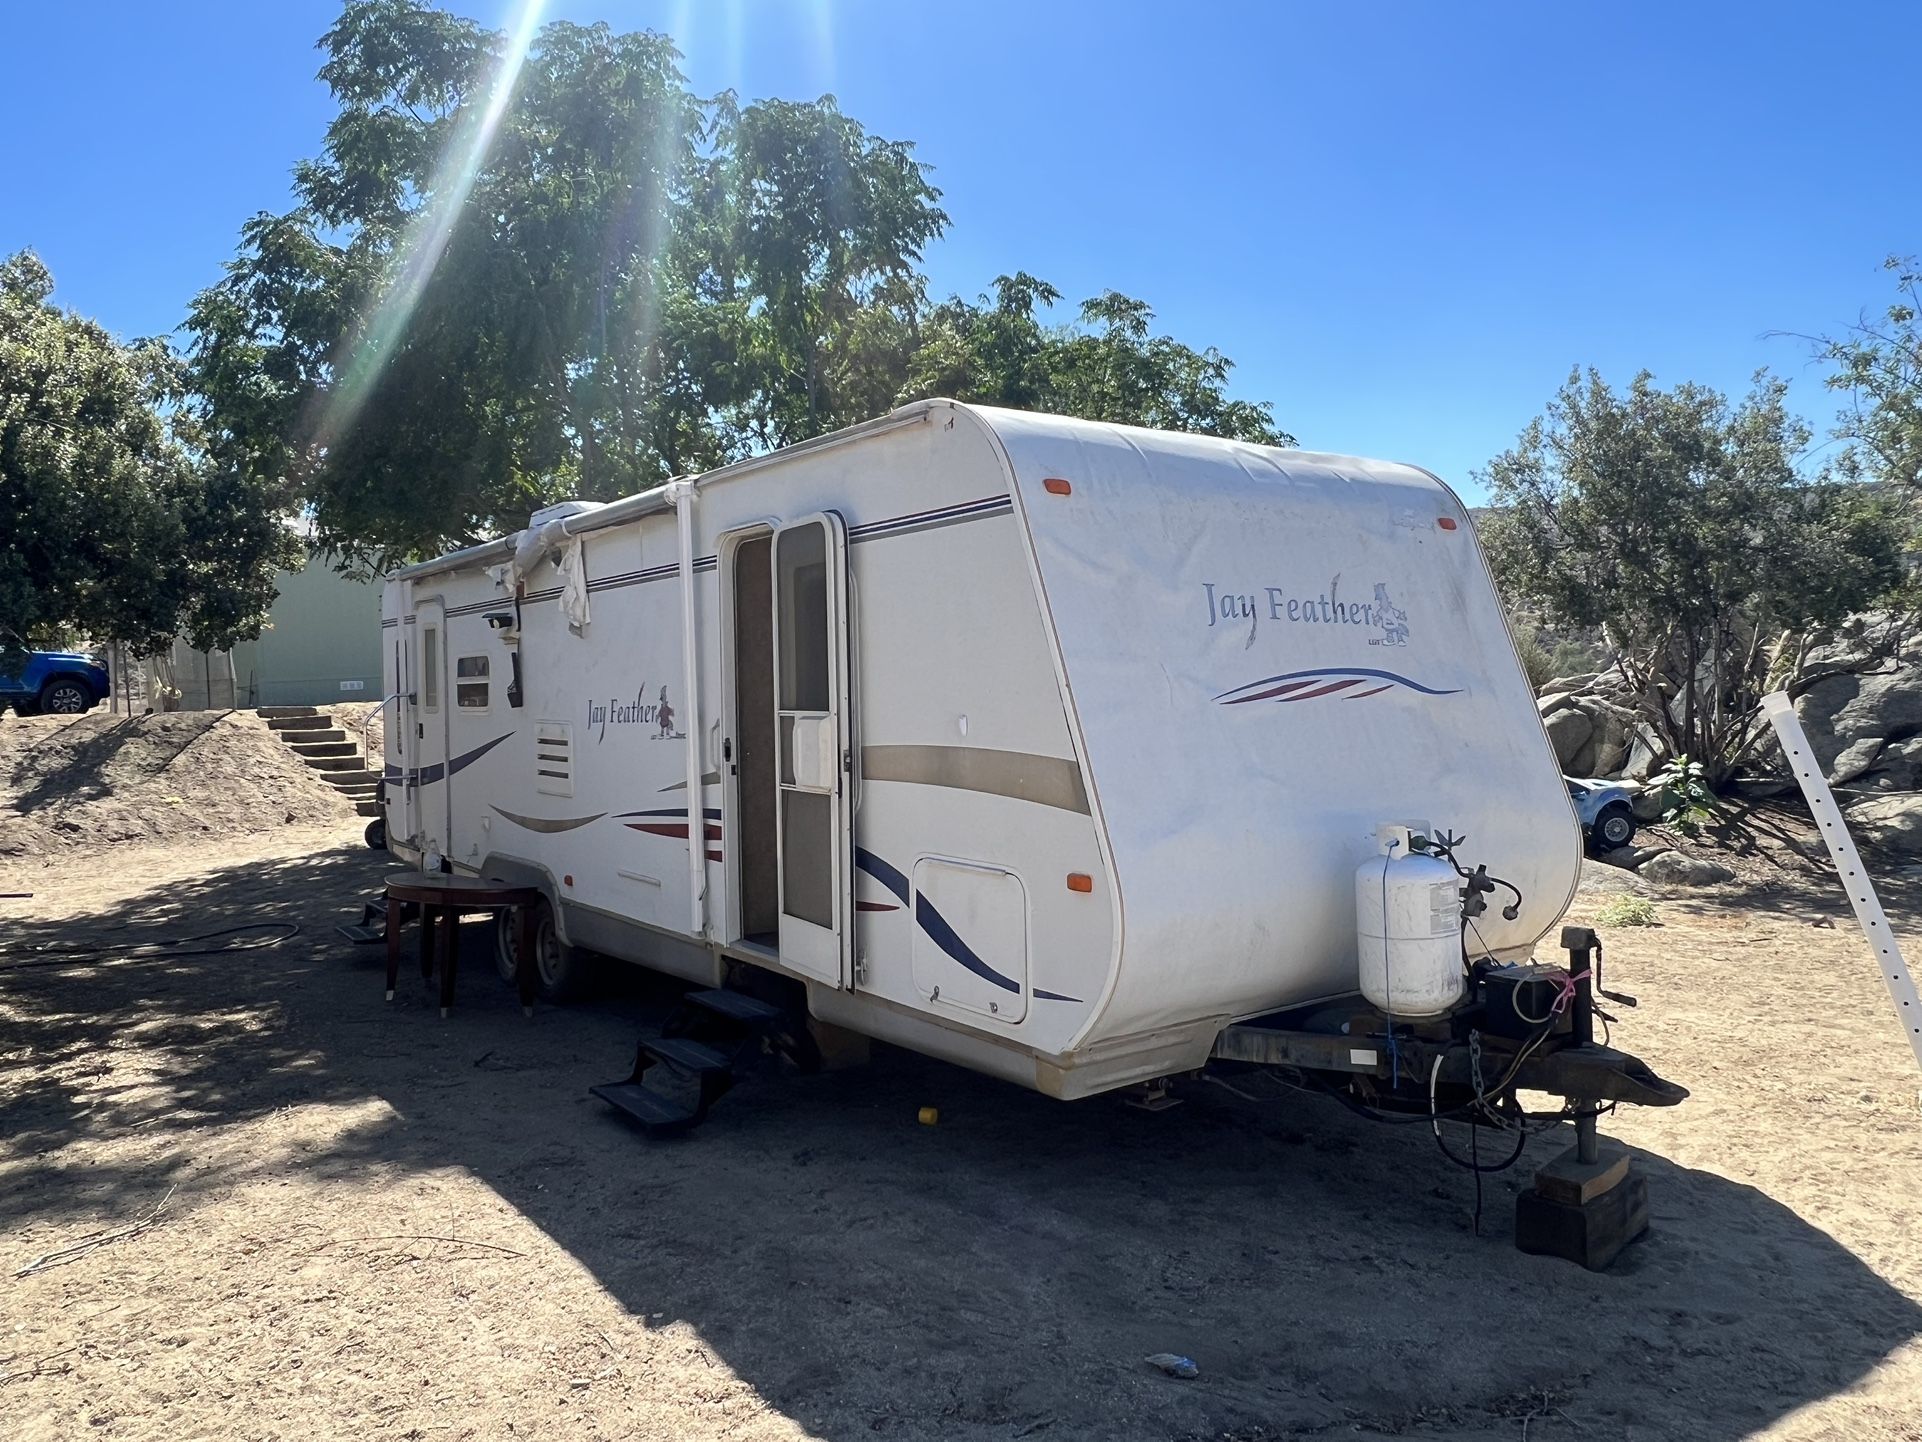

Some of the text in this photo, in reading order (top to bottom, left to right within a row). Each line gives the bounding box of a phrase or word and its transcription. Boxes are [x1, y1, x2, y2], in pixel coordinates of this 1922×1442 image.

[1202, 572, 1373, 650] Jay Feather
[587, 681, 658, 745] Jay Feather
